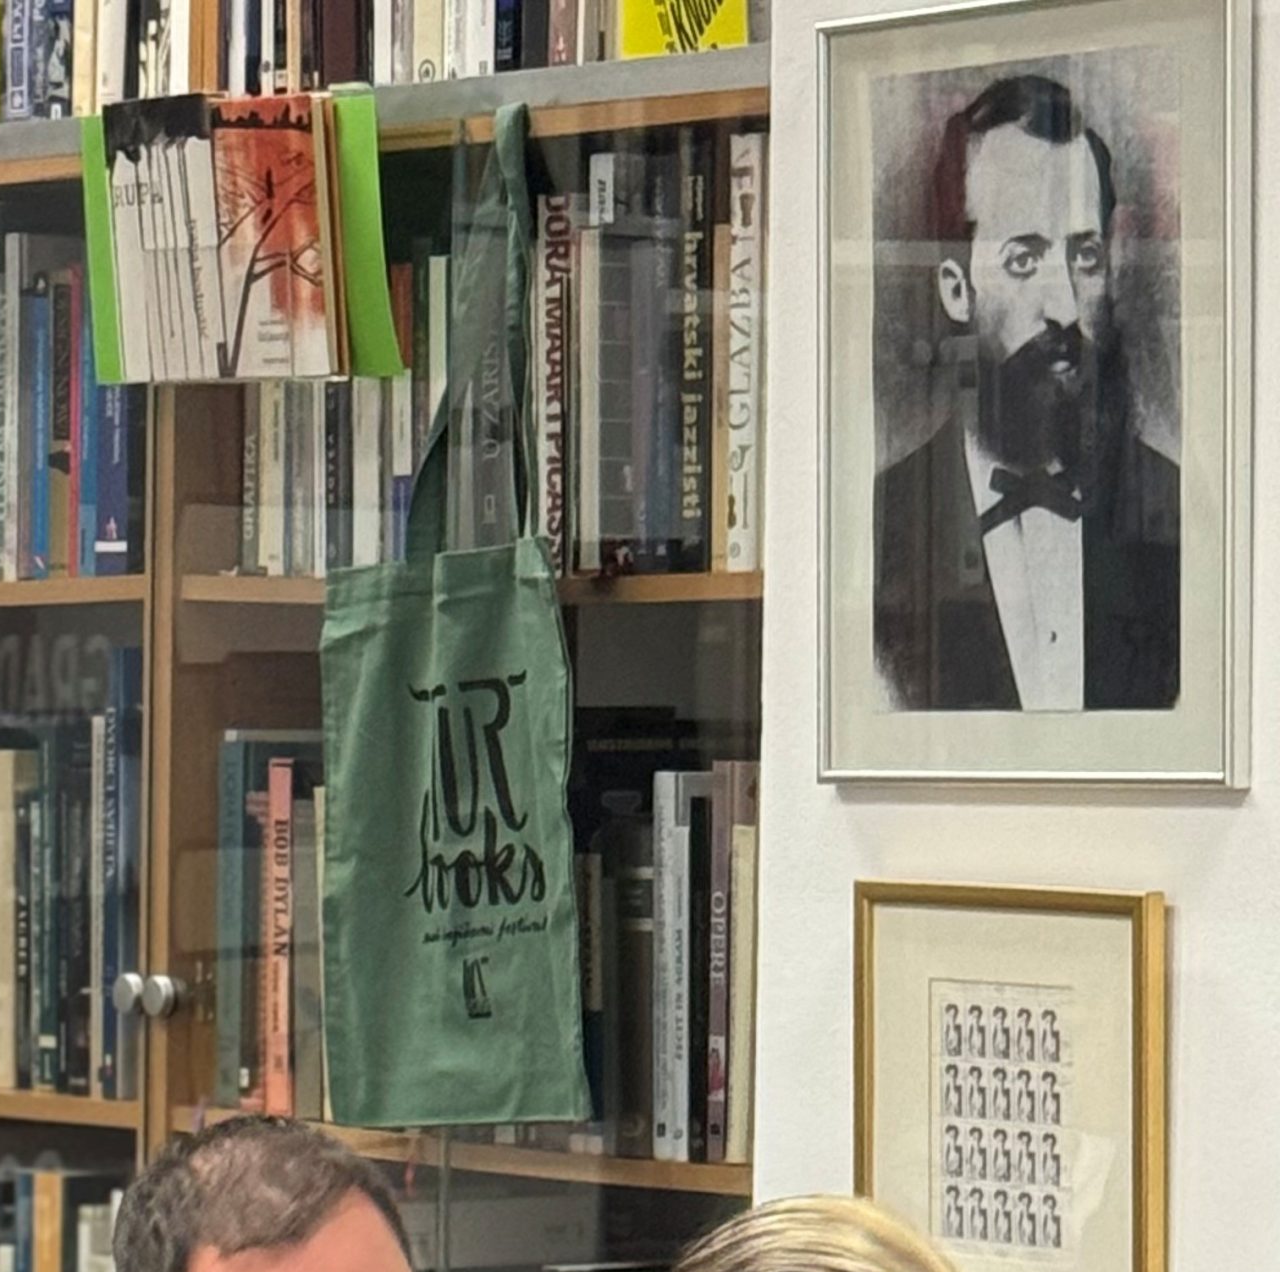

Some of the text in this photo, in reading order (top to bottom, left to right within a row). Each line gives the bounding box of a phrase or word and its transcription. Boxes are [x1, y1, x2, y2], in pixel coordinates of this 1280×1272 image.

[681, 231, 703, 381] hrvatski
[727, 254, 752, 431] GLAZBA
[243, 433, 257, 539] GRAFIKA
[680, 391, 703, 520] jazzisti
[273, 818, 290, 868] BOB
[273, 876, 290, 959] DYLAN
